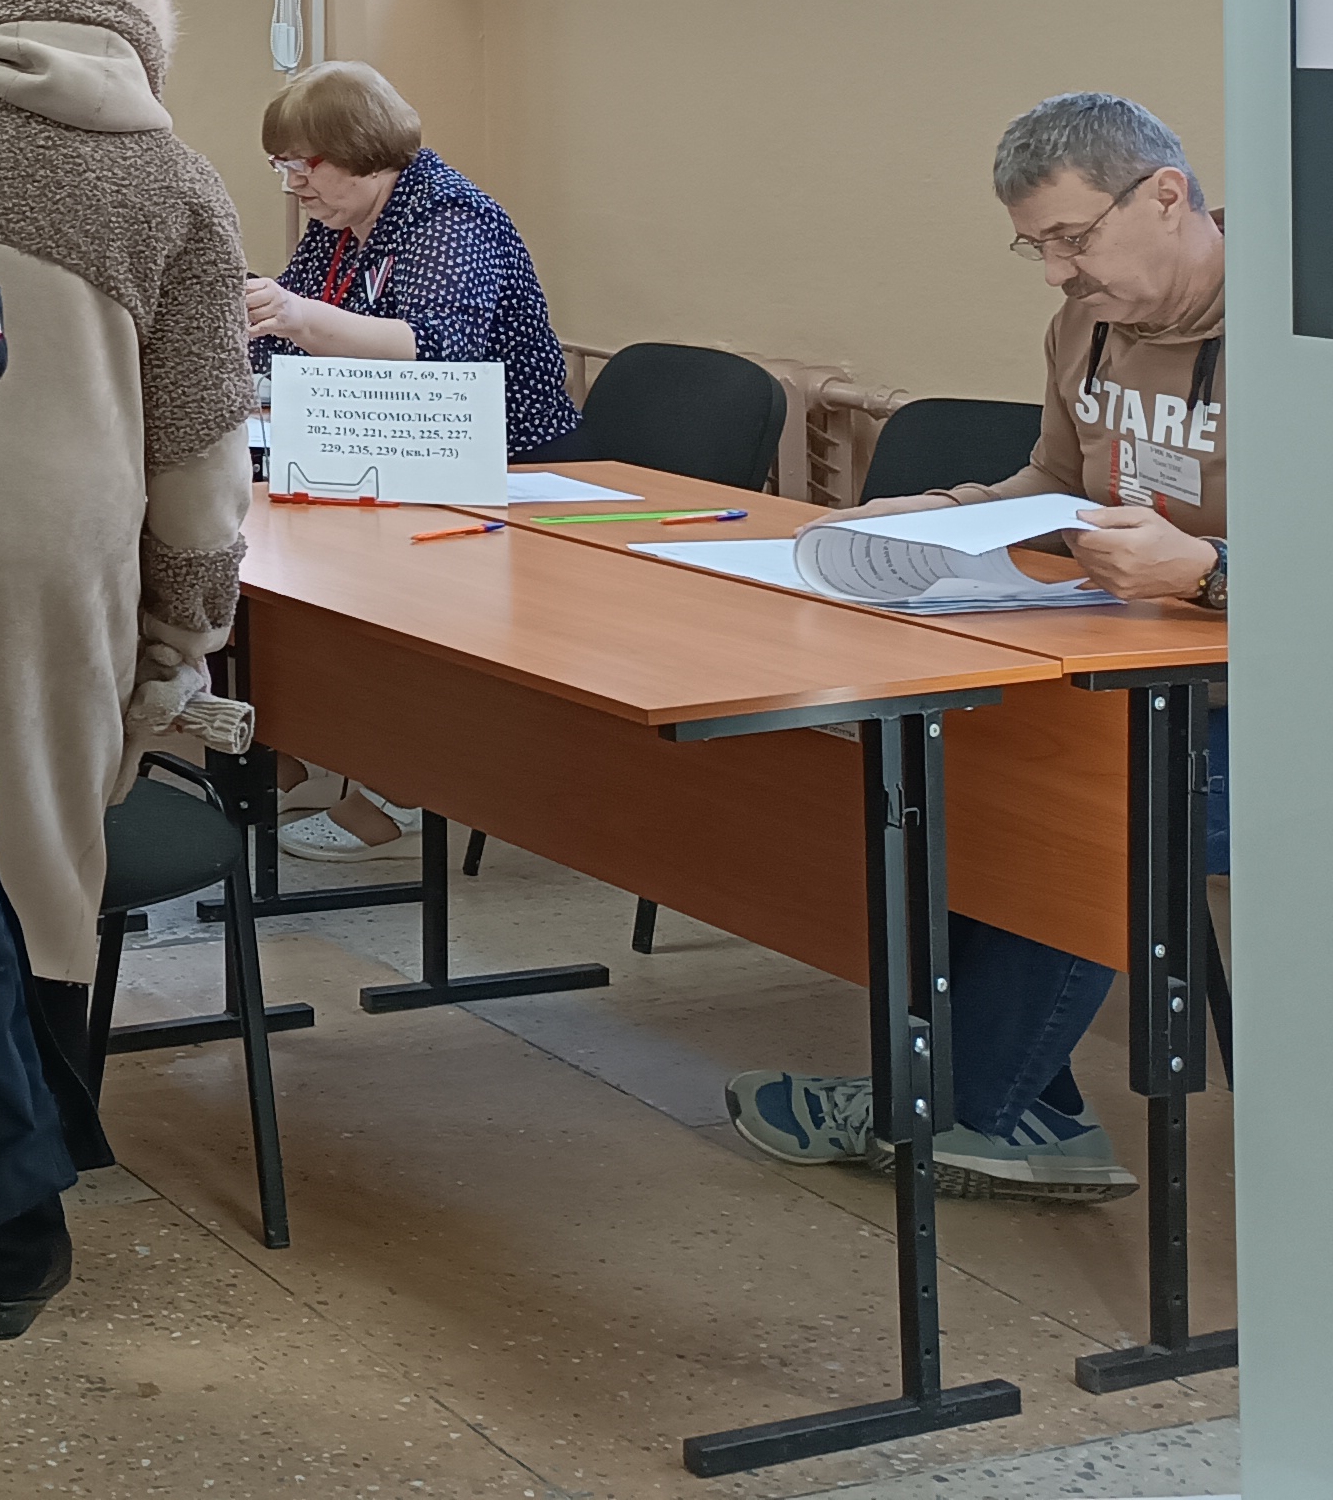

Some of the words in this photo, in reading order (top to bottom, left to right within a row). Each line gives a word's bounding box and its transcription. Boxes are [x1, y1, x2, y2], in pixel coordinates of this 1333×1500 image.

[300, 366, 324, 377] УЛ.
[327, 367, 392, 380] ГАЗОВАЯ
[462, 371, 477, 381] 73
[310, 387, 335, 398] УЛ.
[338, 388, 421, 401] КАЛИНИНА
[306, 407, 330, 419] УЛ.
[333, 409, 472, 423] КОМСОМОЛЬСКАЯ
[1075, 377, 1222, 453] STARE
[376, 446, 398, 457] 239
